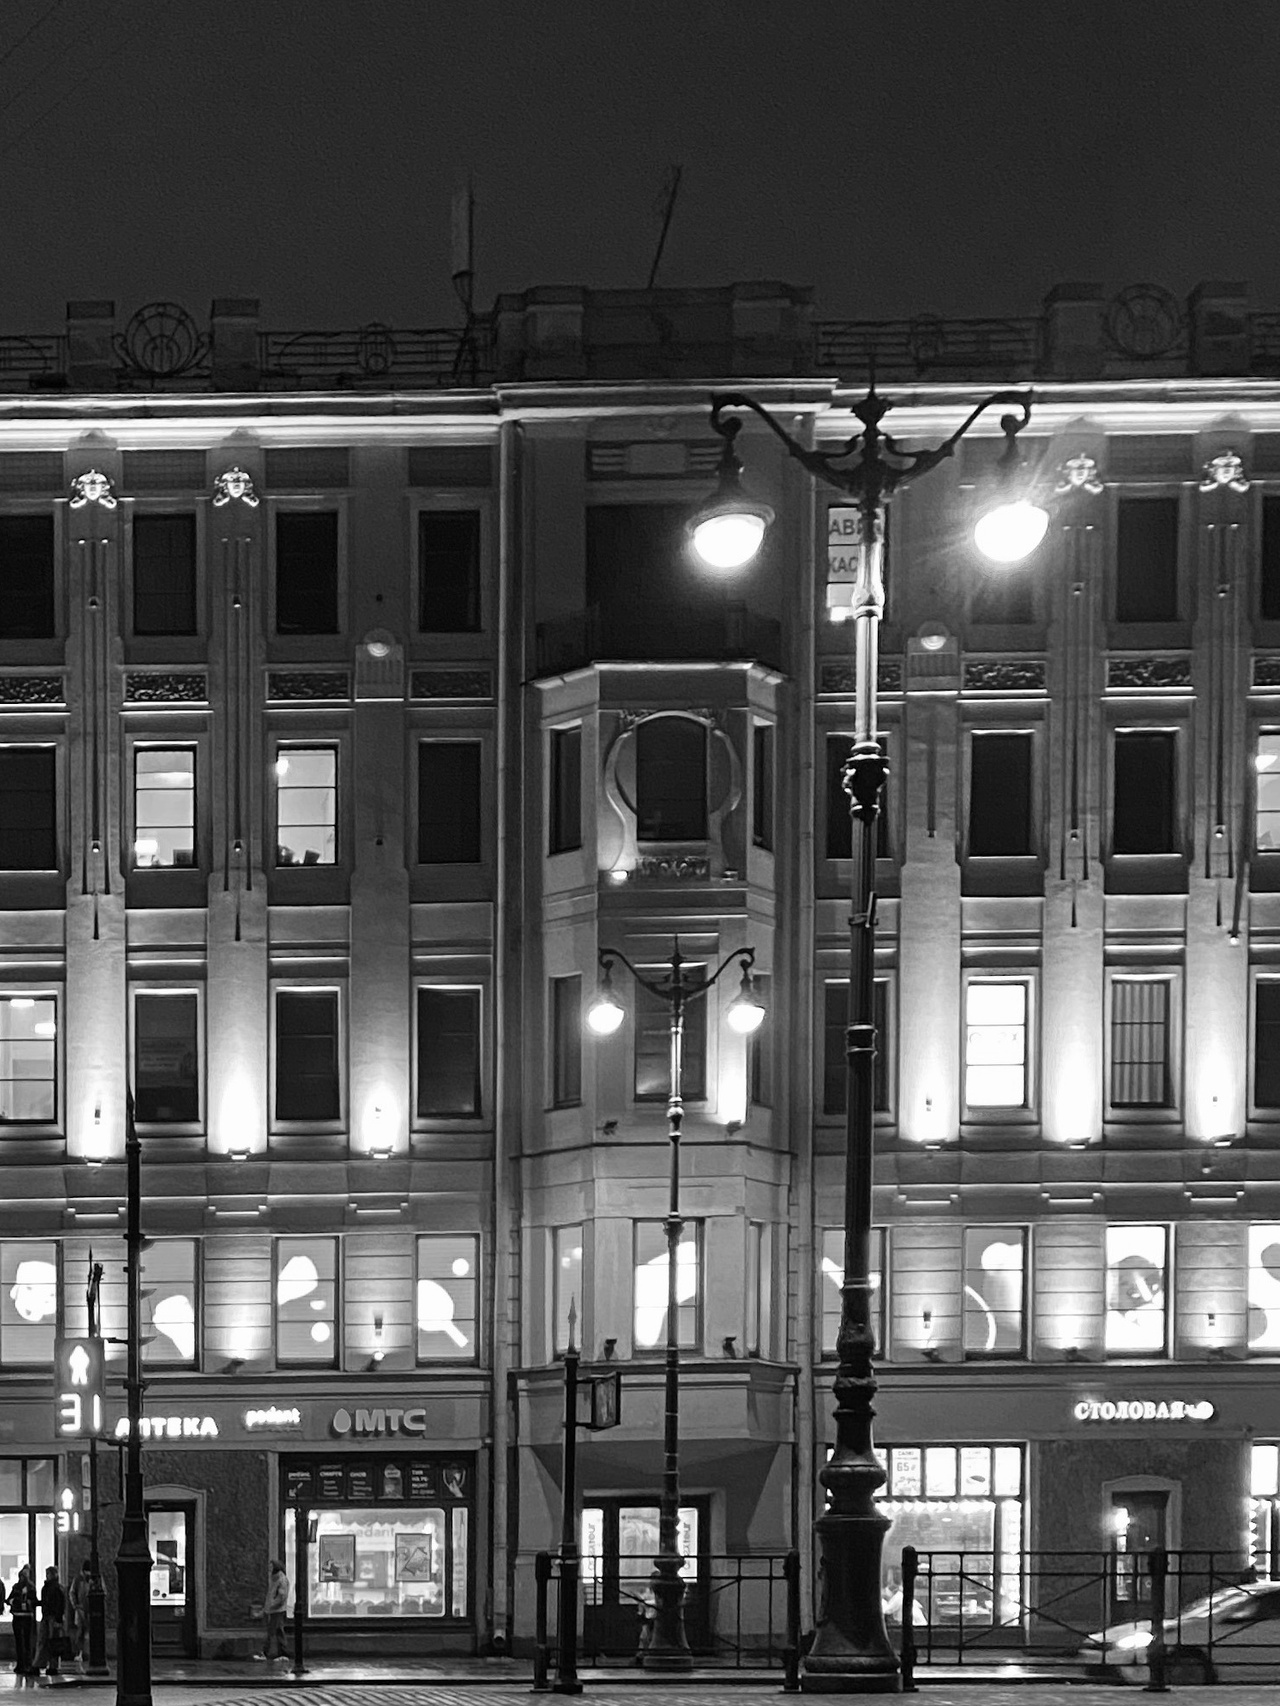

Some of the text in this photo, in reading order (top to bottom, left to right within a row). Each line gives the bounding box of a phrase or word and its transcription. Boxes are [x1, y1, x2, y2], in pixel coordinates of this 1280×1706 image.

[60, 1393, 101, 1432] 31
[355, 1408, 426, 1431] МТС
[1074, 1401, 1185, 1420] СТОЛОВАЯ
[57, 1511, 79, 1532] 31
